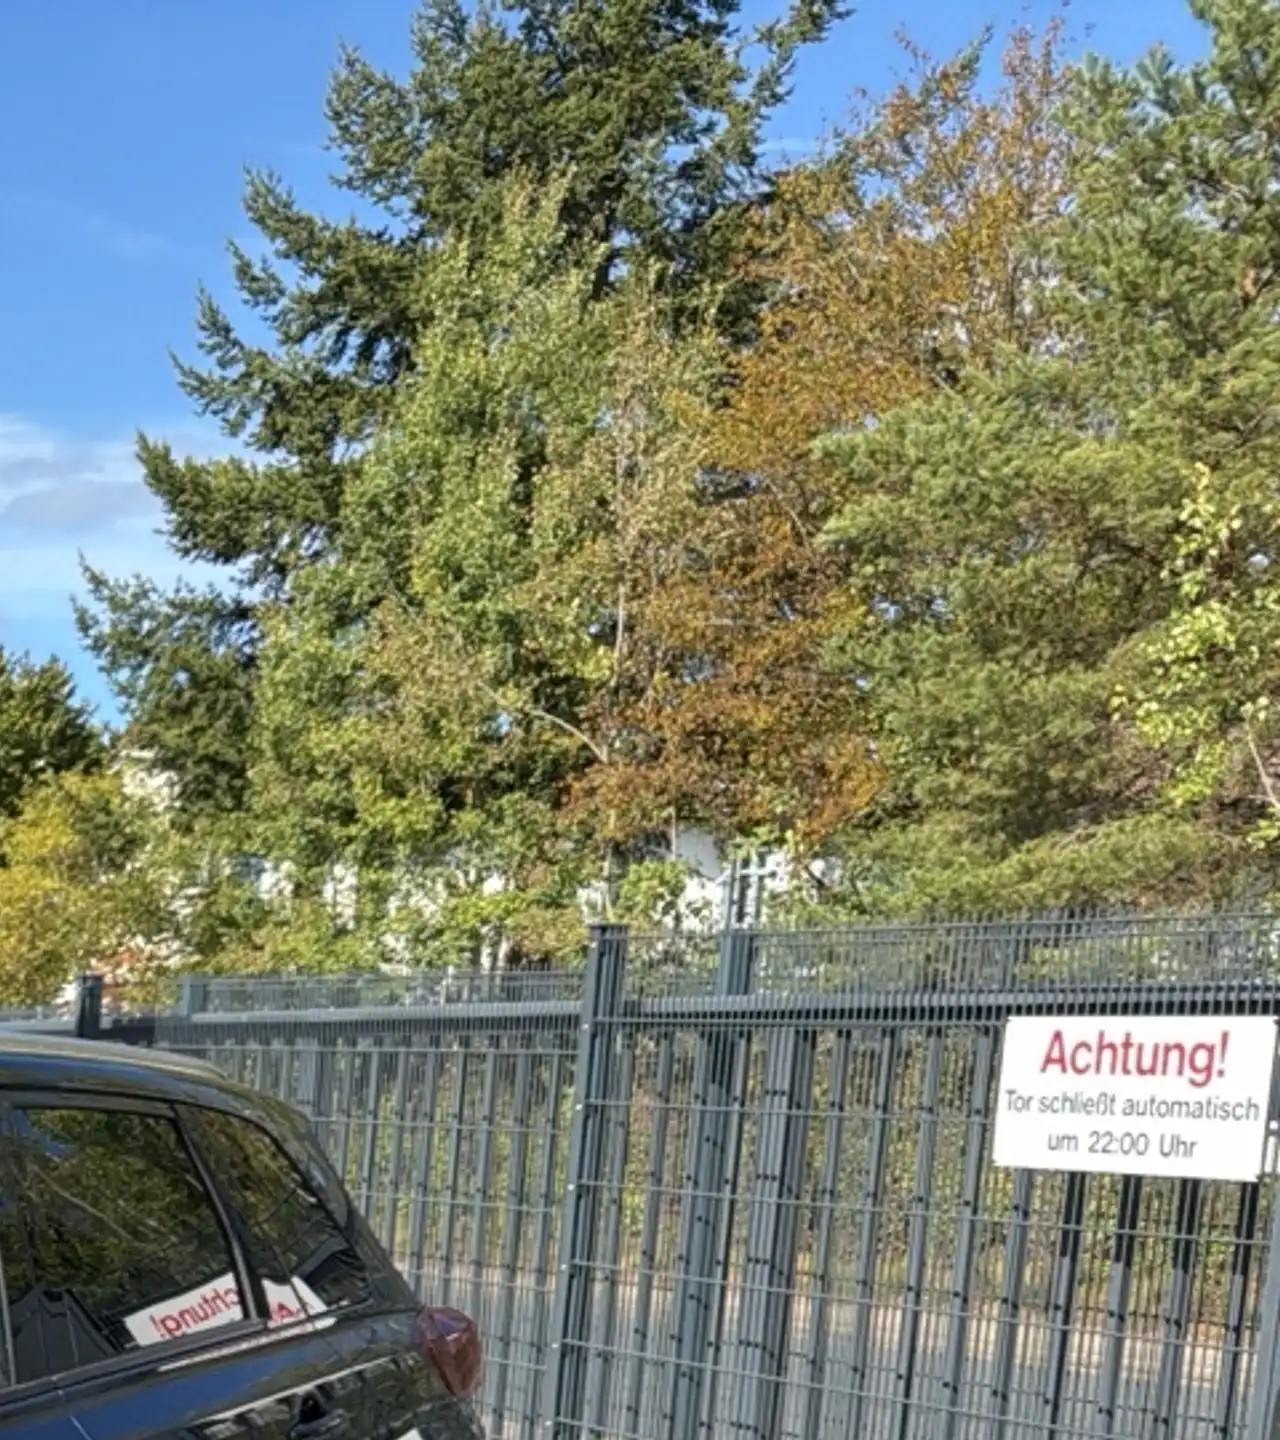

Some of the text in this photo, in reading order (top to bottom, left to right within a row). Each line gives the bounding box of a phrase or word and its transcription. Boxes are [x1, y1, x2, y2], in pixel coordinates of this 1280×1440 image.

[1040, 1028, 1230, 1089] Achtung!
[1005, 1089, 1260, 1122] Tor schließt automatisch
[1047, 1131, 1198, 1159] um 22:00 Uhr
